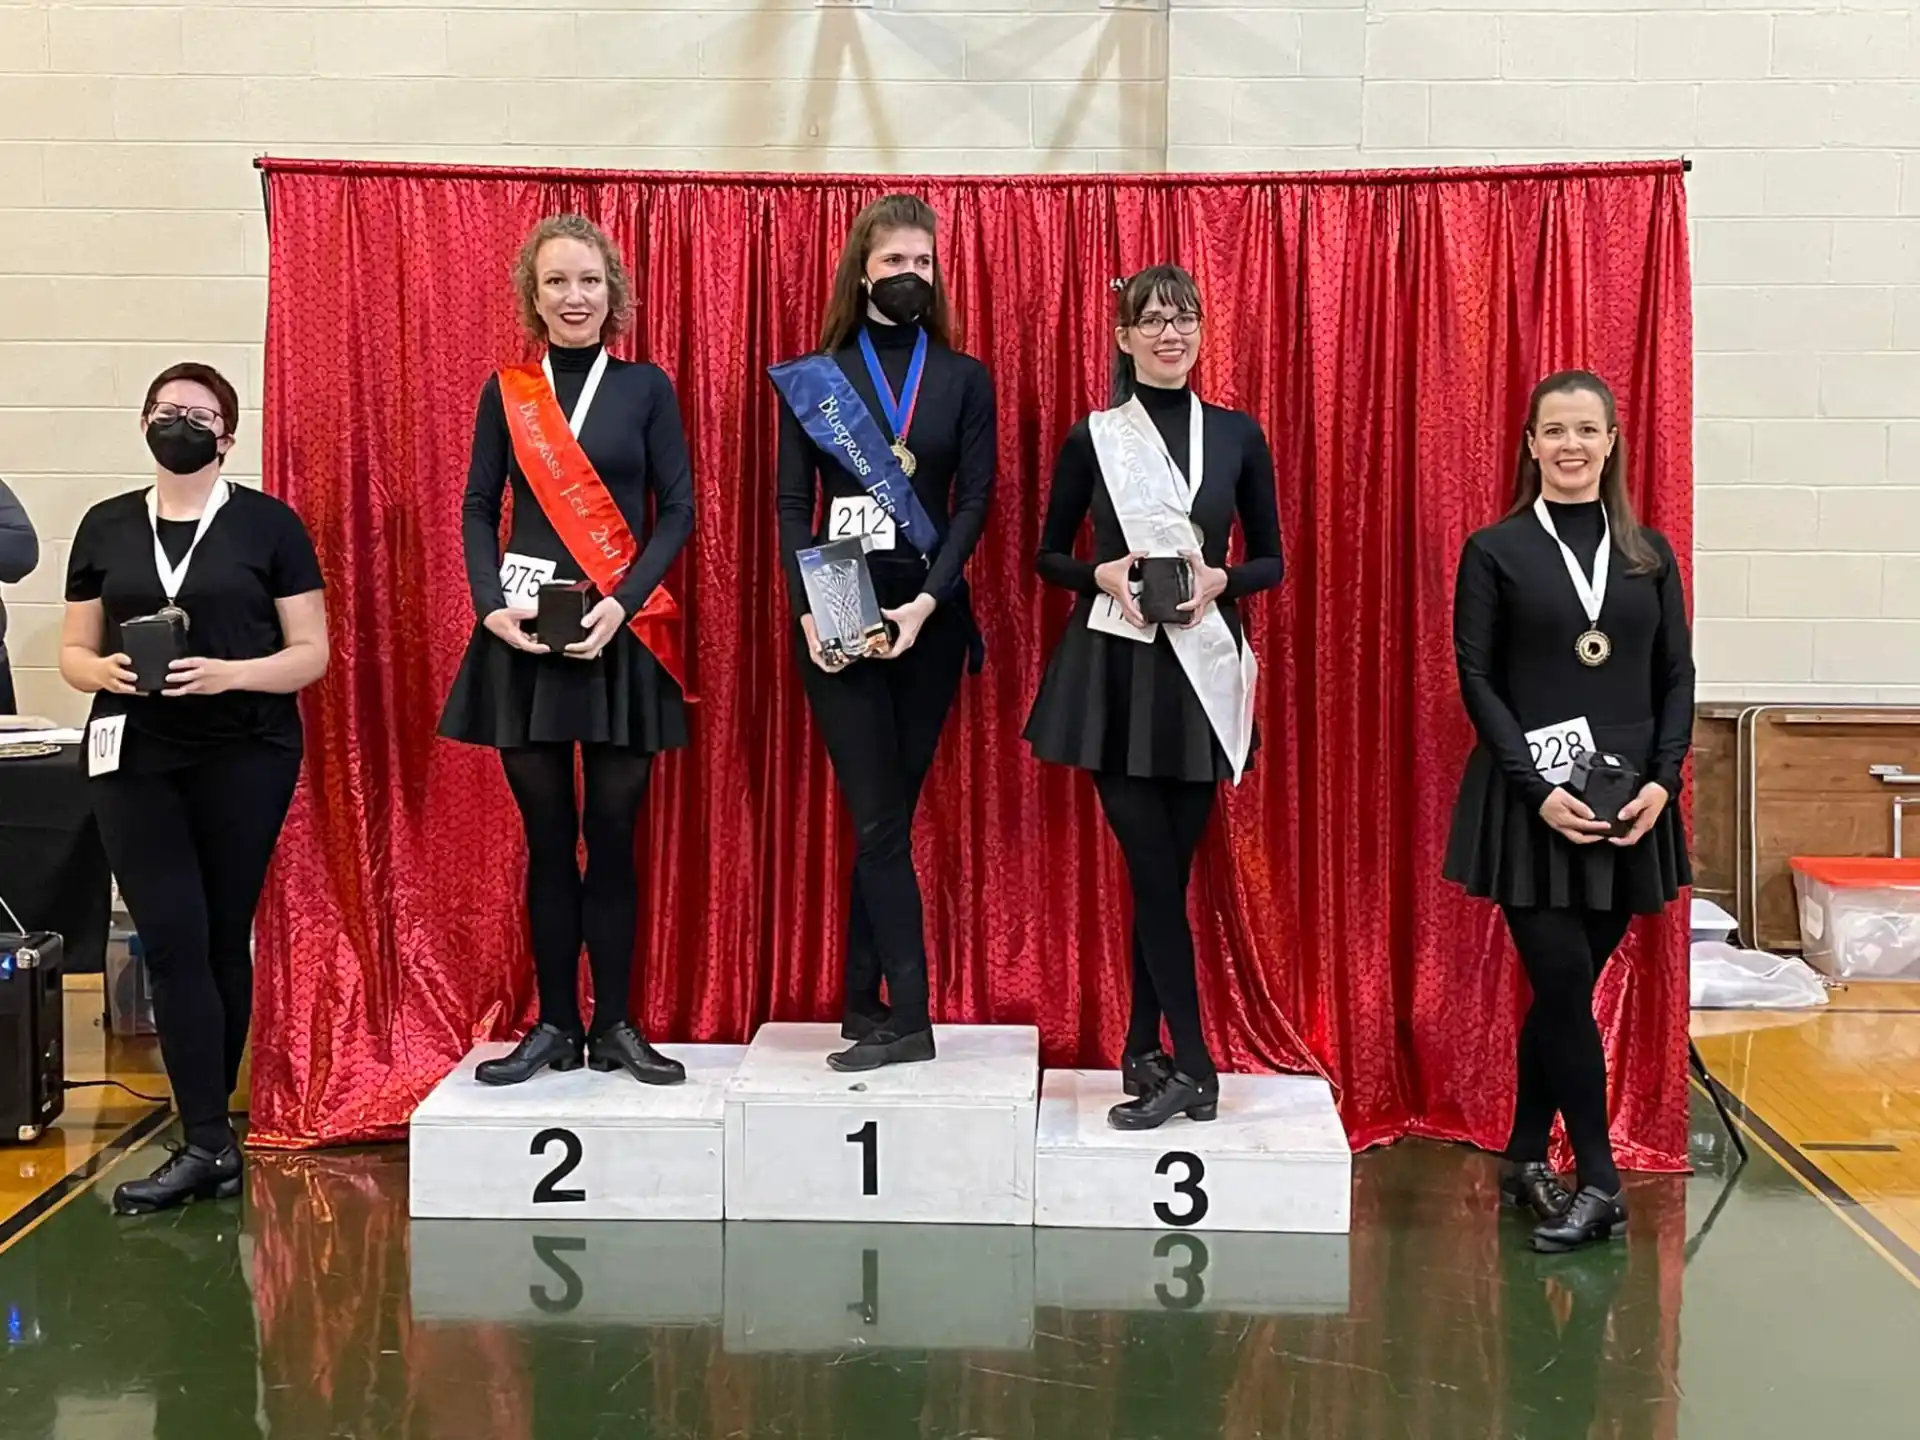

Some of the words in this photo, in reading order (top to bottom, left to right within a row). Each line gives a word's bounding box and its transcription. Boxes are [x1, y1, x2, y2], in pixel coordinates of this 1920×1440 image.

[818, 393, 872, 476] Bluegrass
[837, 505, 888, 536] 212
[588, 524, 622, 560] 2nd
[501, 563, 545, 598] 275
[93, 724, 117, 758] 101
[1529, 731, 1586, 772] 228
[530, 1127, 586, 1204] 2
[846, 1121, 878, 1196] 1
[1153, 1151, 1209, 1227] 3
